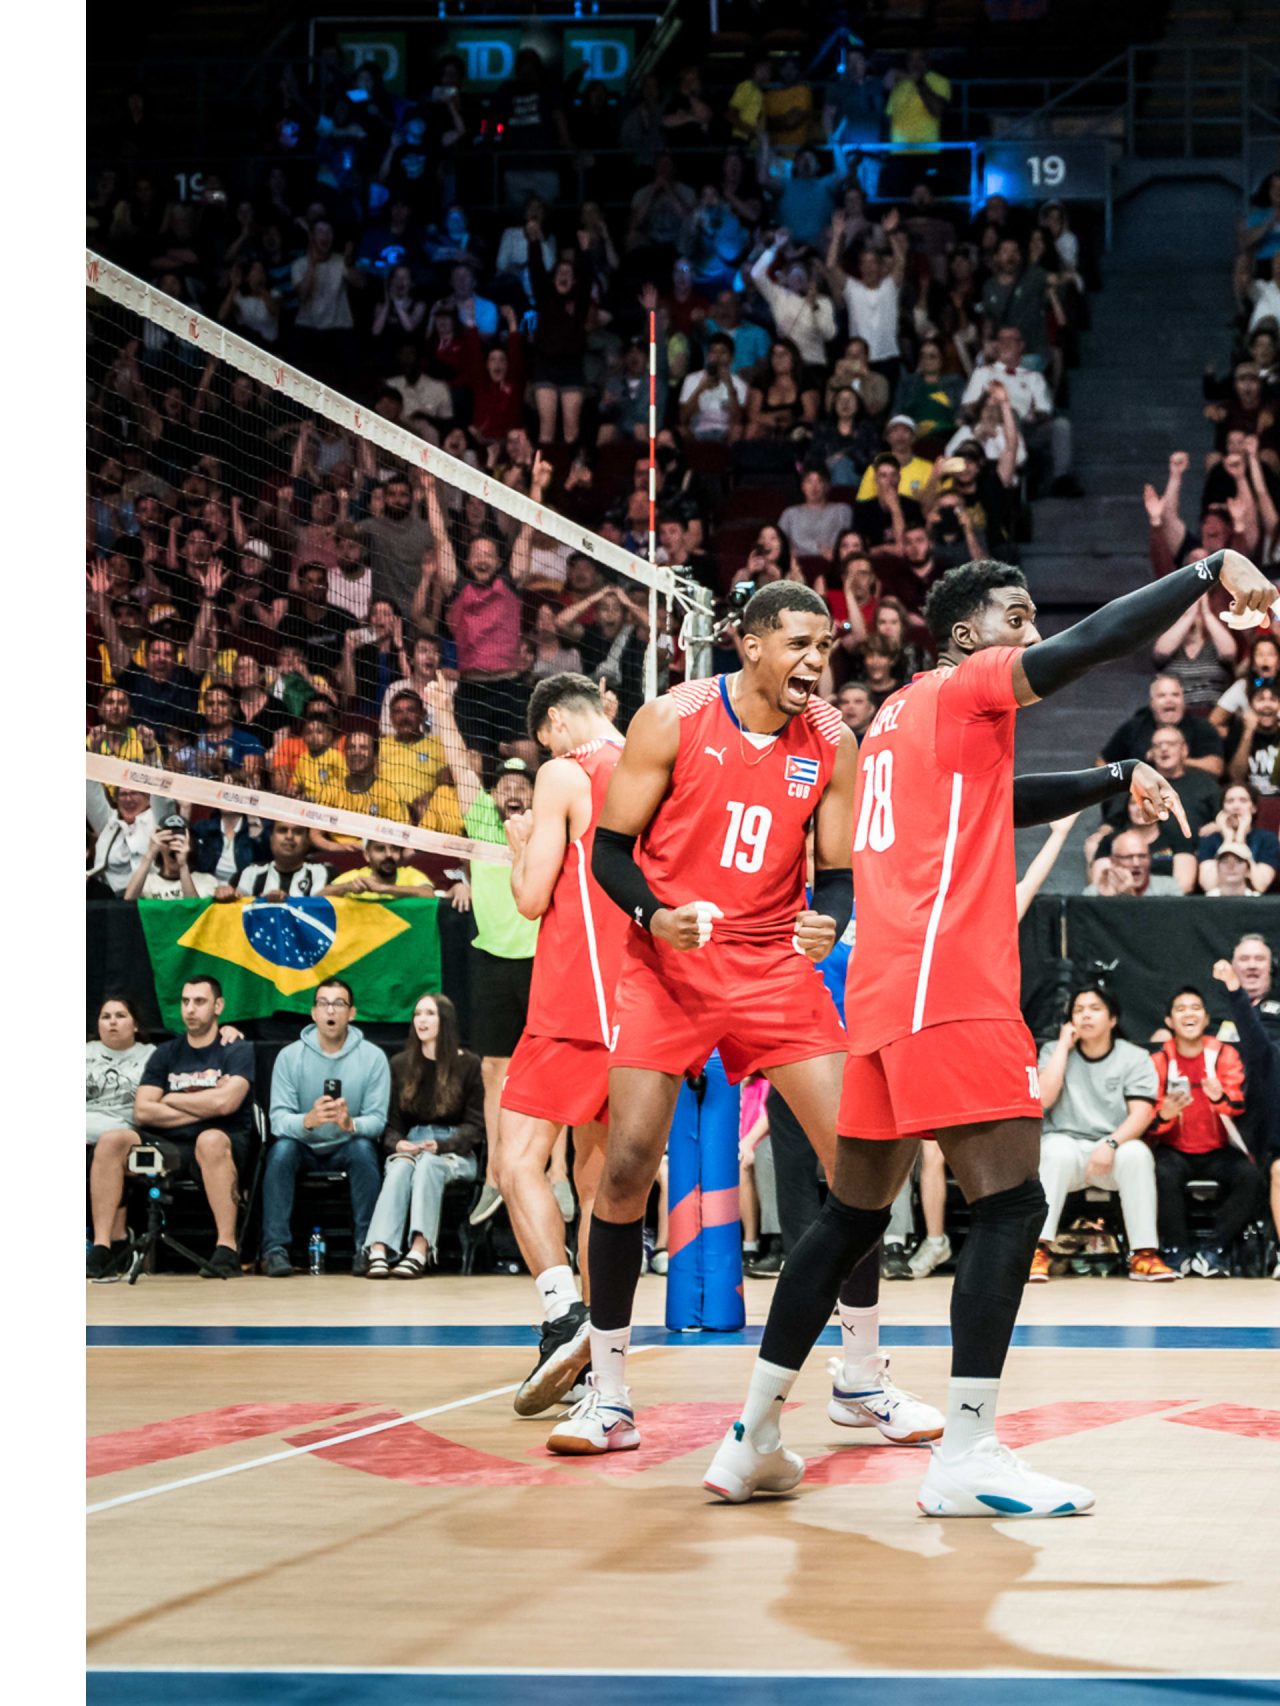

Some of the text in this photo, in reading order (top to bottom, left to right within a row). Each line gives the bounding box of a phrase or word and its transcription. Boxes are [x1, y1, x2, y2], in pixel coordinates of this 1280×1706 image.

[455, 40, 514, 81] TD
[1025, 154, 1067, 187] 19
[787, 782, 811, 799] CUB
[853, 749, 895, 852] 18
[720, 800, 773, 873] 19
